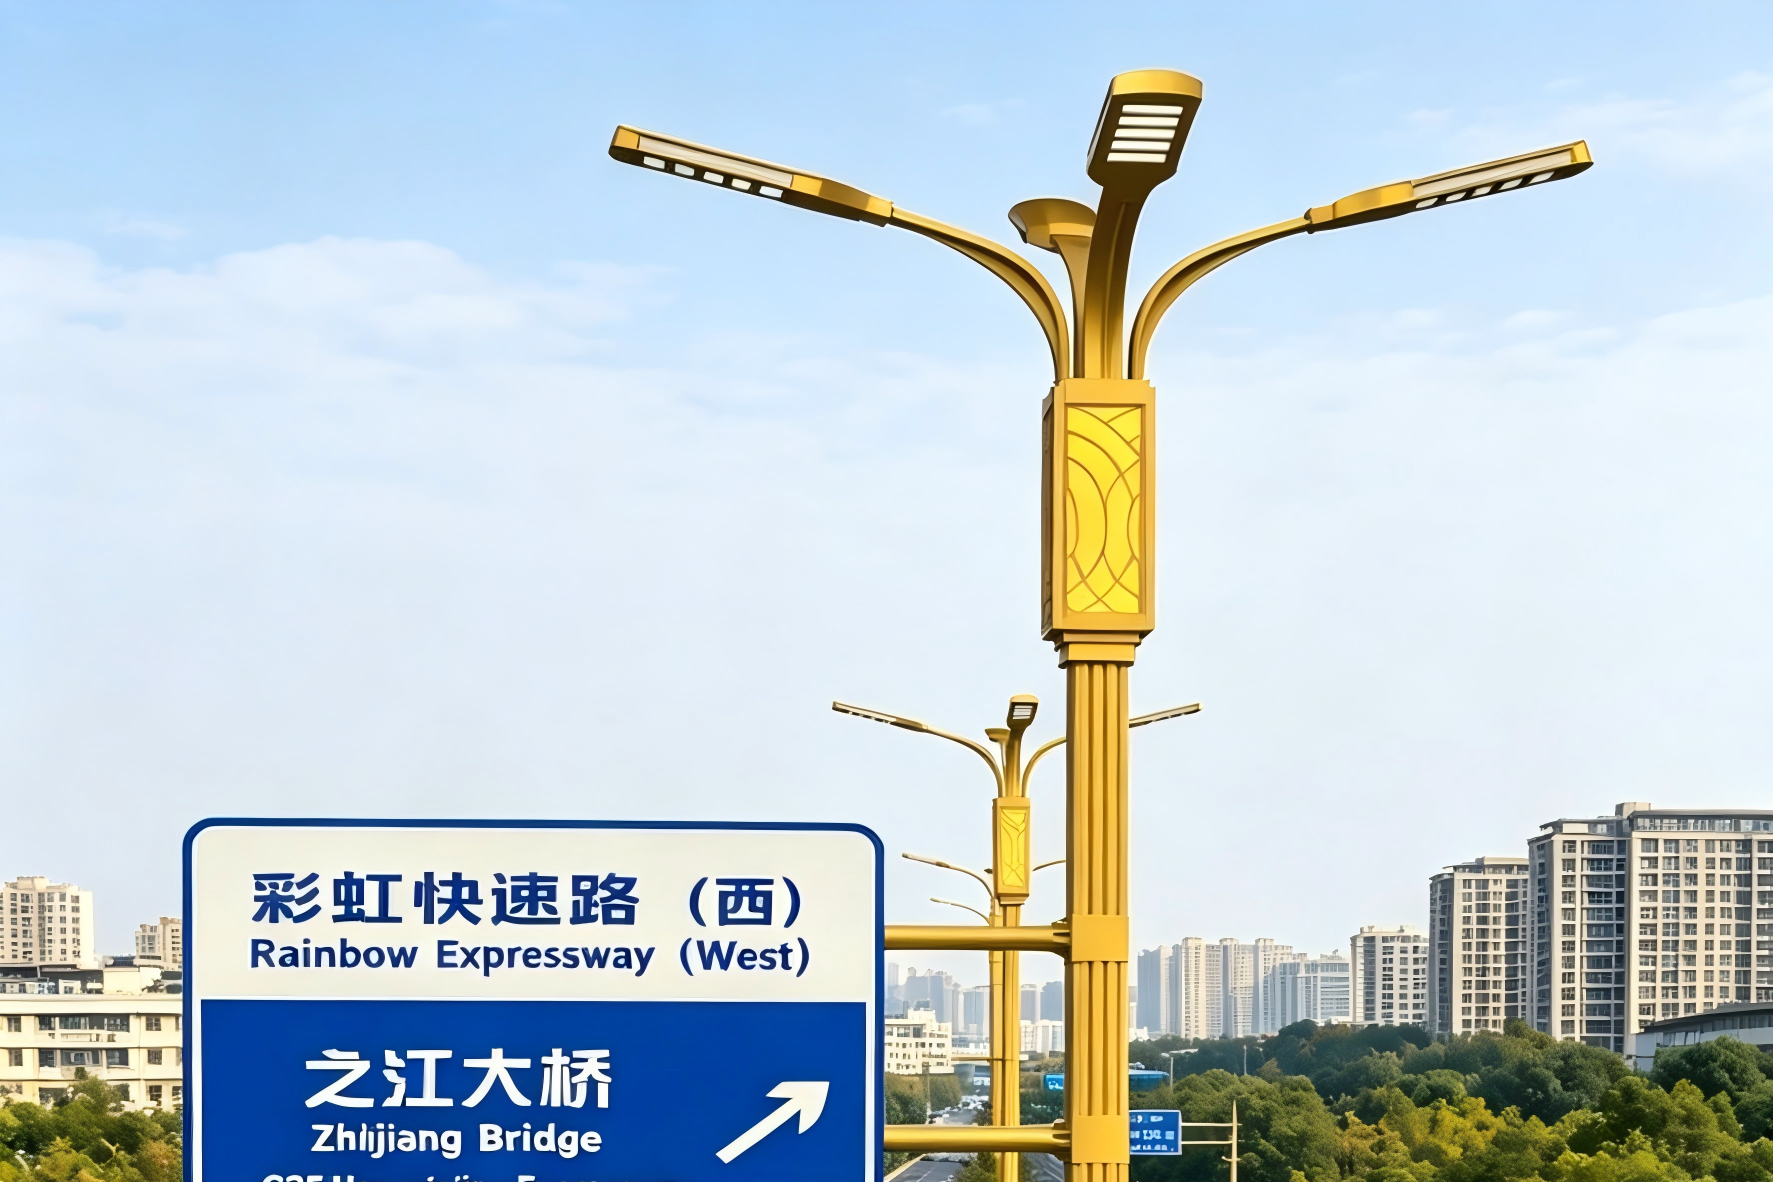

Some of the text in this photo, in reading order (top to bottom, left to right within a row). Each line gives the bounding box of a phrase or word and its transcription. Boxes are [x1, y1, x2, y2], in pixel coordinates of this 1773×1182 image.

[251, 870, 640, 927] 彩虹快速路
[250, 937, 810, 978] Rainbow Expressway (West)
[304, 1047, 612, 1109] 之江大桥
[479, 1122, 603, 1159] Bridge
